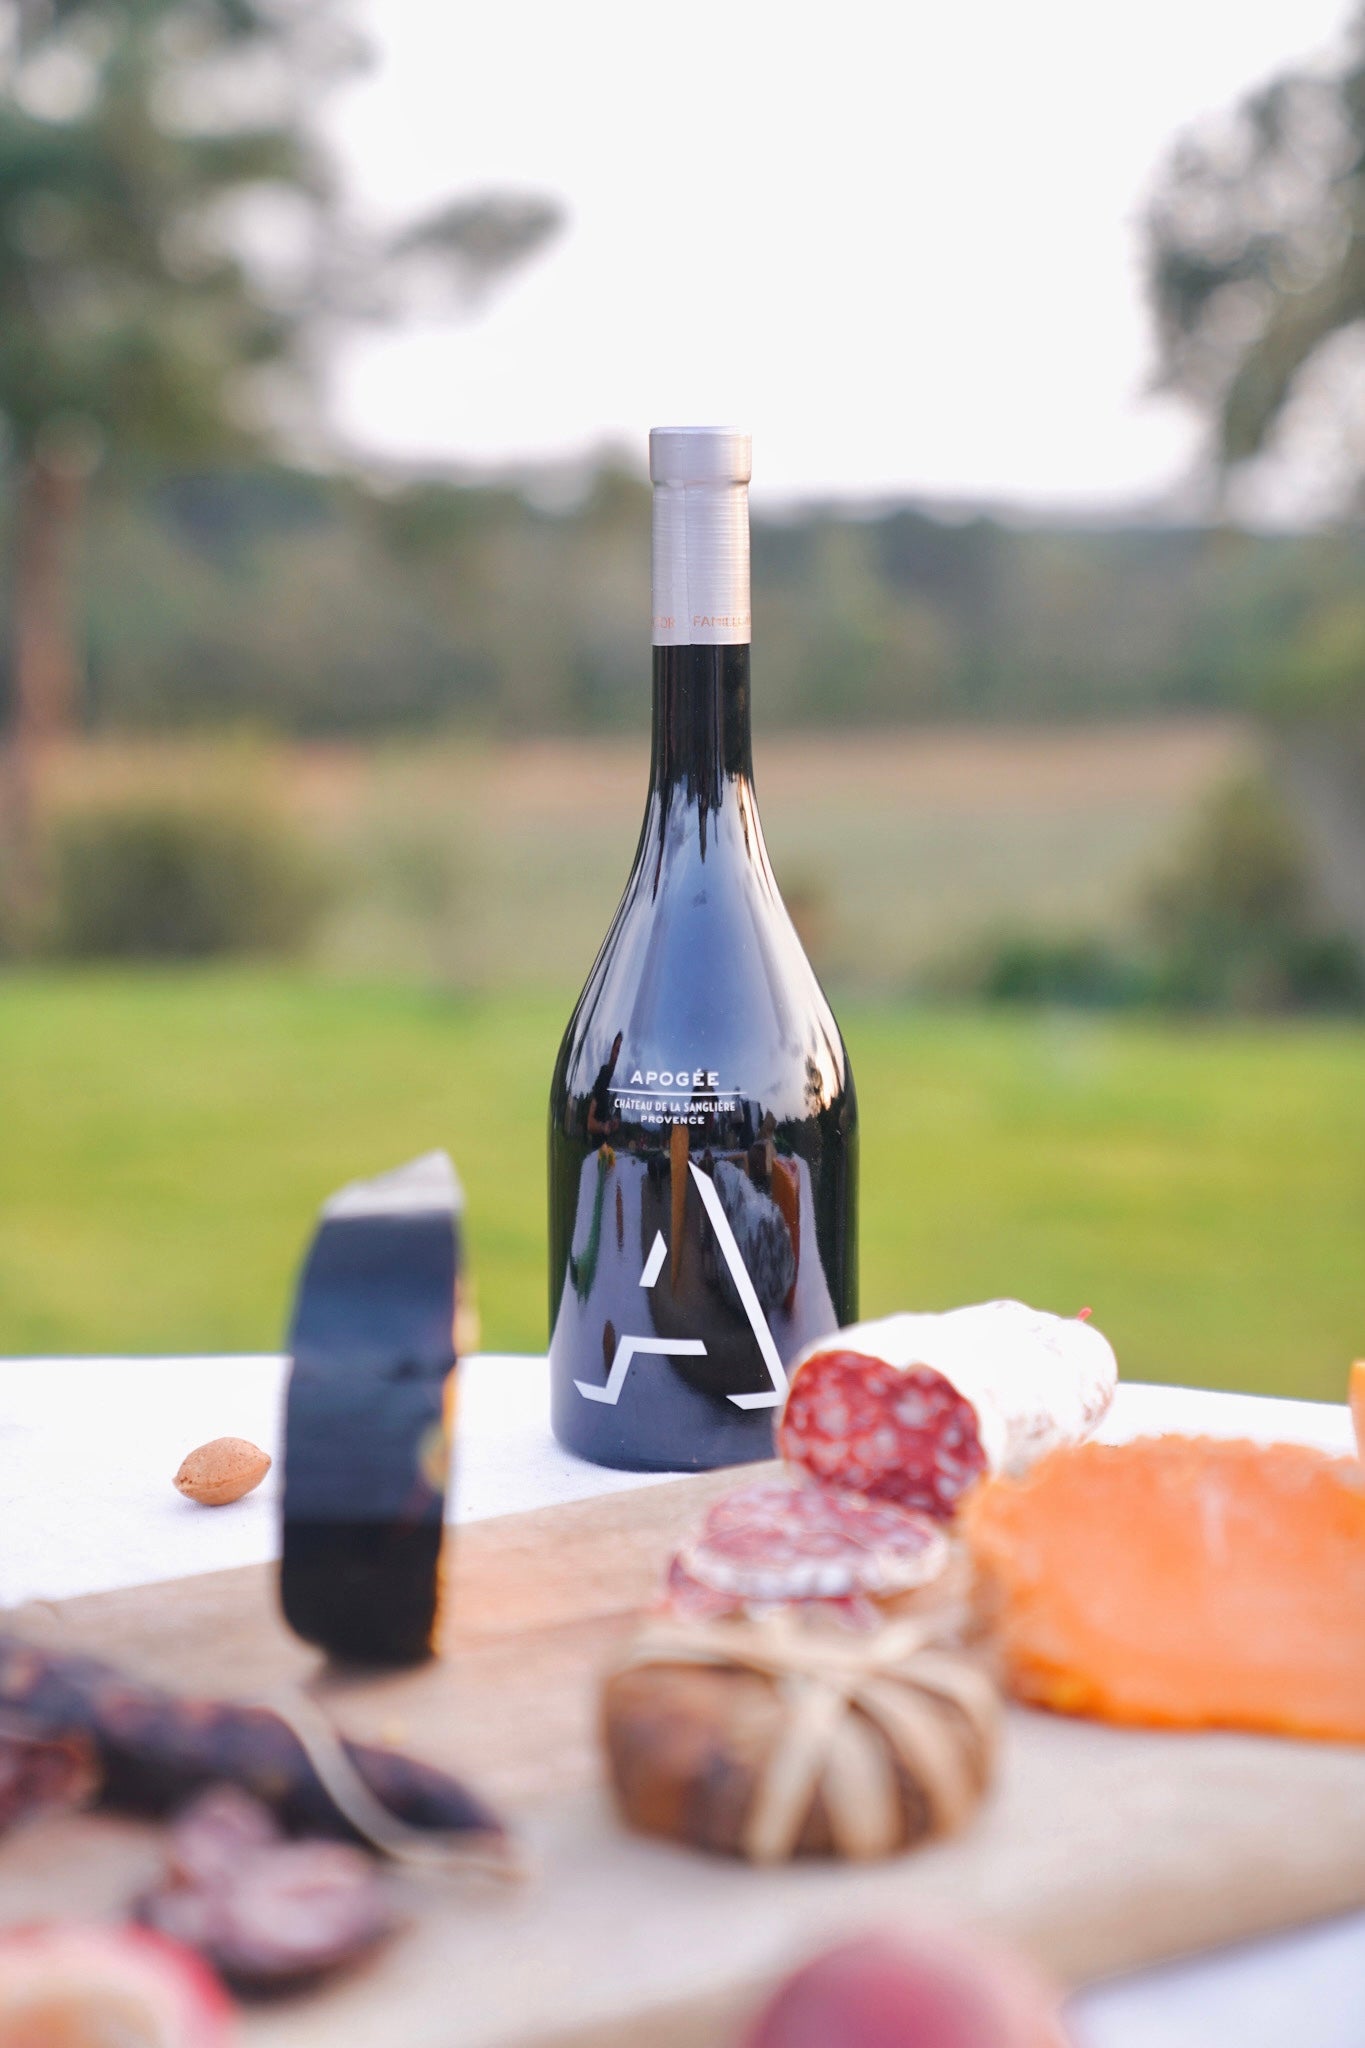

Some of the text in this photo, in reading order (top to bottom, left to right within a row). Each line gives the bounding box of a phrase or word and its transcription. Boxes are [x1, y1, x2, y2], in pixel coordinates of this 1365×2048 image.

[630, 1068, 720, 1087] APOGÉE
[614, 1097, 736, 1113] CHÂTEAU DE LA SANGLIÈRE
[640, 1115, 705, 1126] PROVENCE
